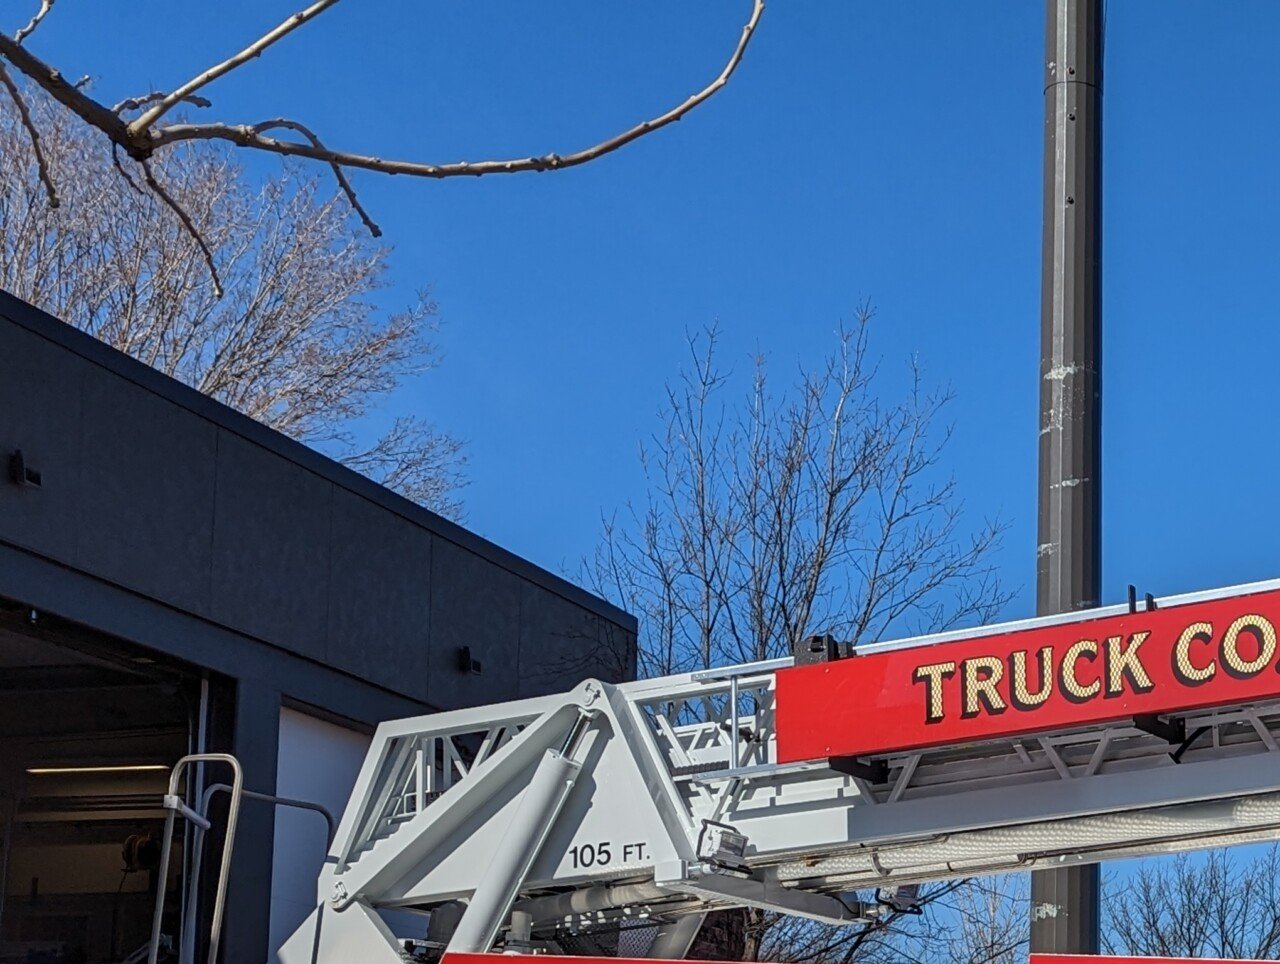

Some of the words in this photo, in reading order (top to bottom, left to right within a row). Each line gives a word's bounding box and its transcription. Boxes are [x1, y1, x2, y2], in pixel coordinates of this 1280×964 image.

[913, 631, 1156, 724] TRUCK
[569, 842, 611, 868] 105
[623, 842, 650, 862] FT.
